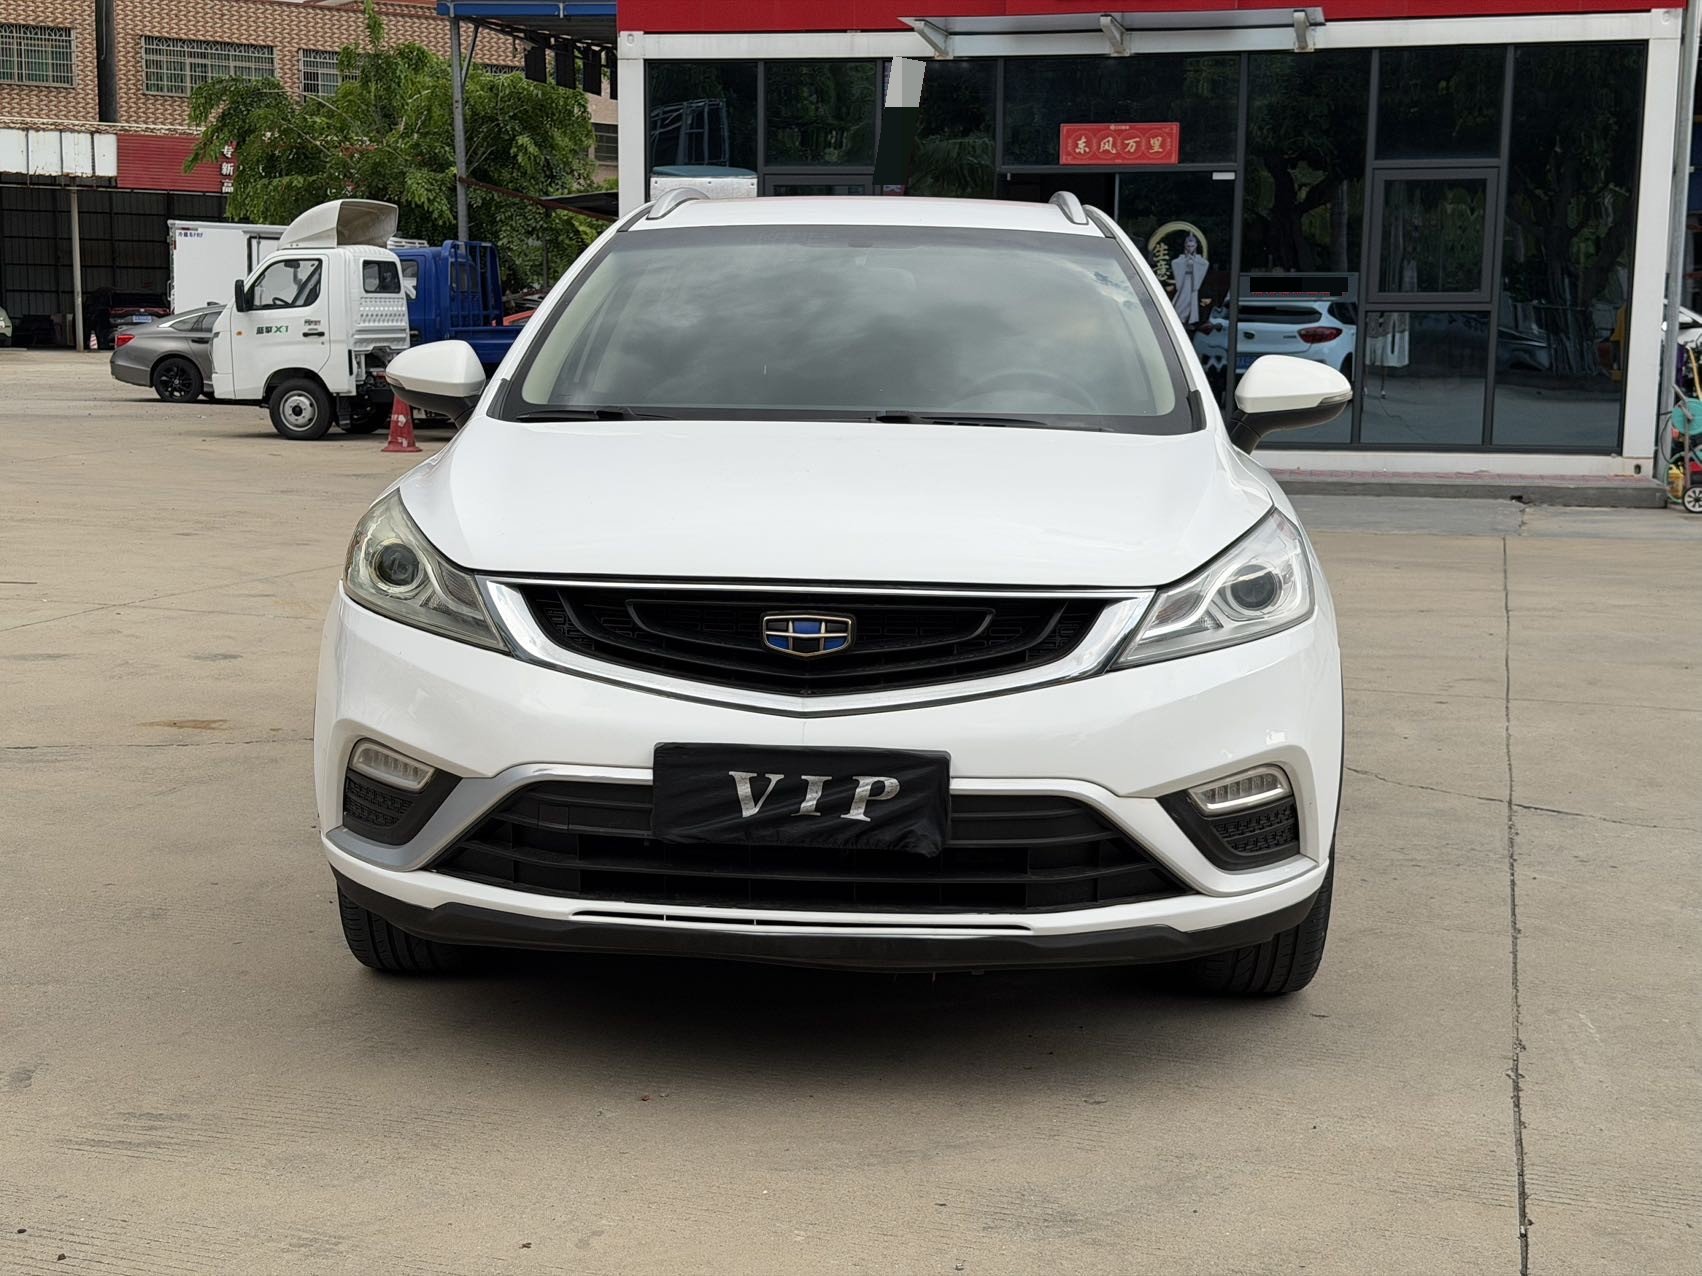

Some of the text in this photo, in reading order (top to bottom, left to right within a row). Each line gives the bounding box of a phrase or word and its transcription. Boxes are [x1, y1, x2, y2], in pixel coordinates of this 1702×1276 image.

[1075, 136, 1163, 153] 东风万里
[729, 771, 900, 821] VIP
